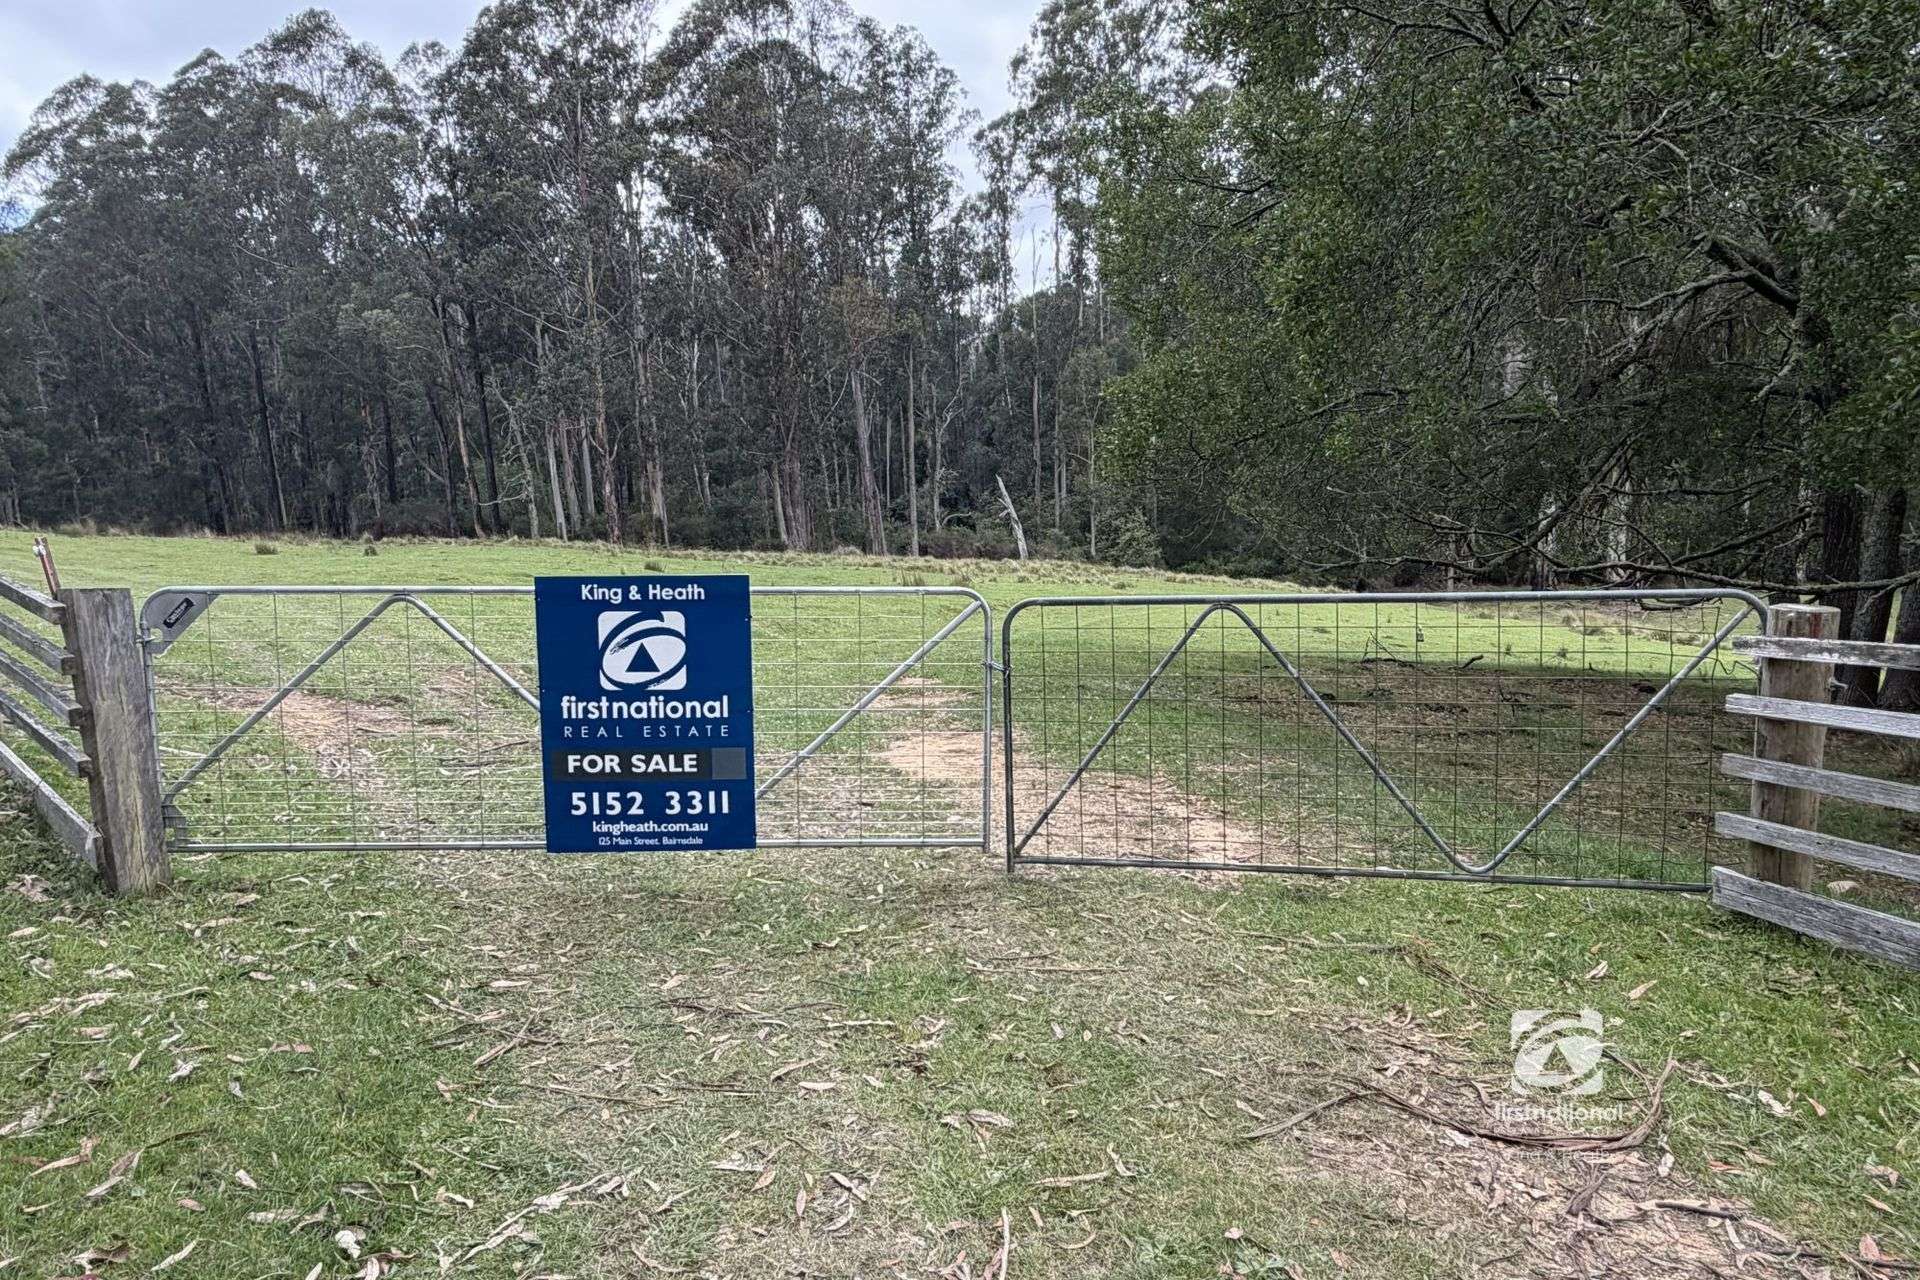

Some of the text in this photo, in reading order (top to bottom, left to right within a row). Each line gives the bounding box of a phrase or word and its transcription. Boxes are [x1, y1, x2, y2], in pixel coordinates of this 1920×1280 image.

[582, 584, 705, 604] King & Heath
[565, 725, 729, 738] REAL ESTATE
[568, 754, 698, 773] FOR SALE
[571, 790, 729, 815] 5152 3311
[593, 820, 709, 835] kingheath.com.au
[598, 837, 611, 845] 125
[613, 837, 632, 845] Main
[662, 836, 703, 845] Bairnsdale
